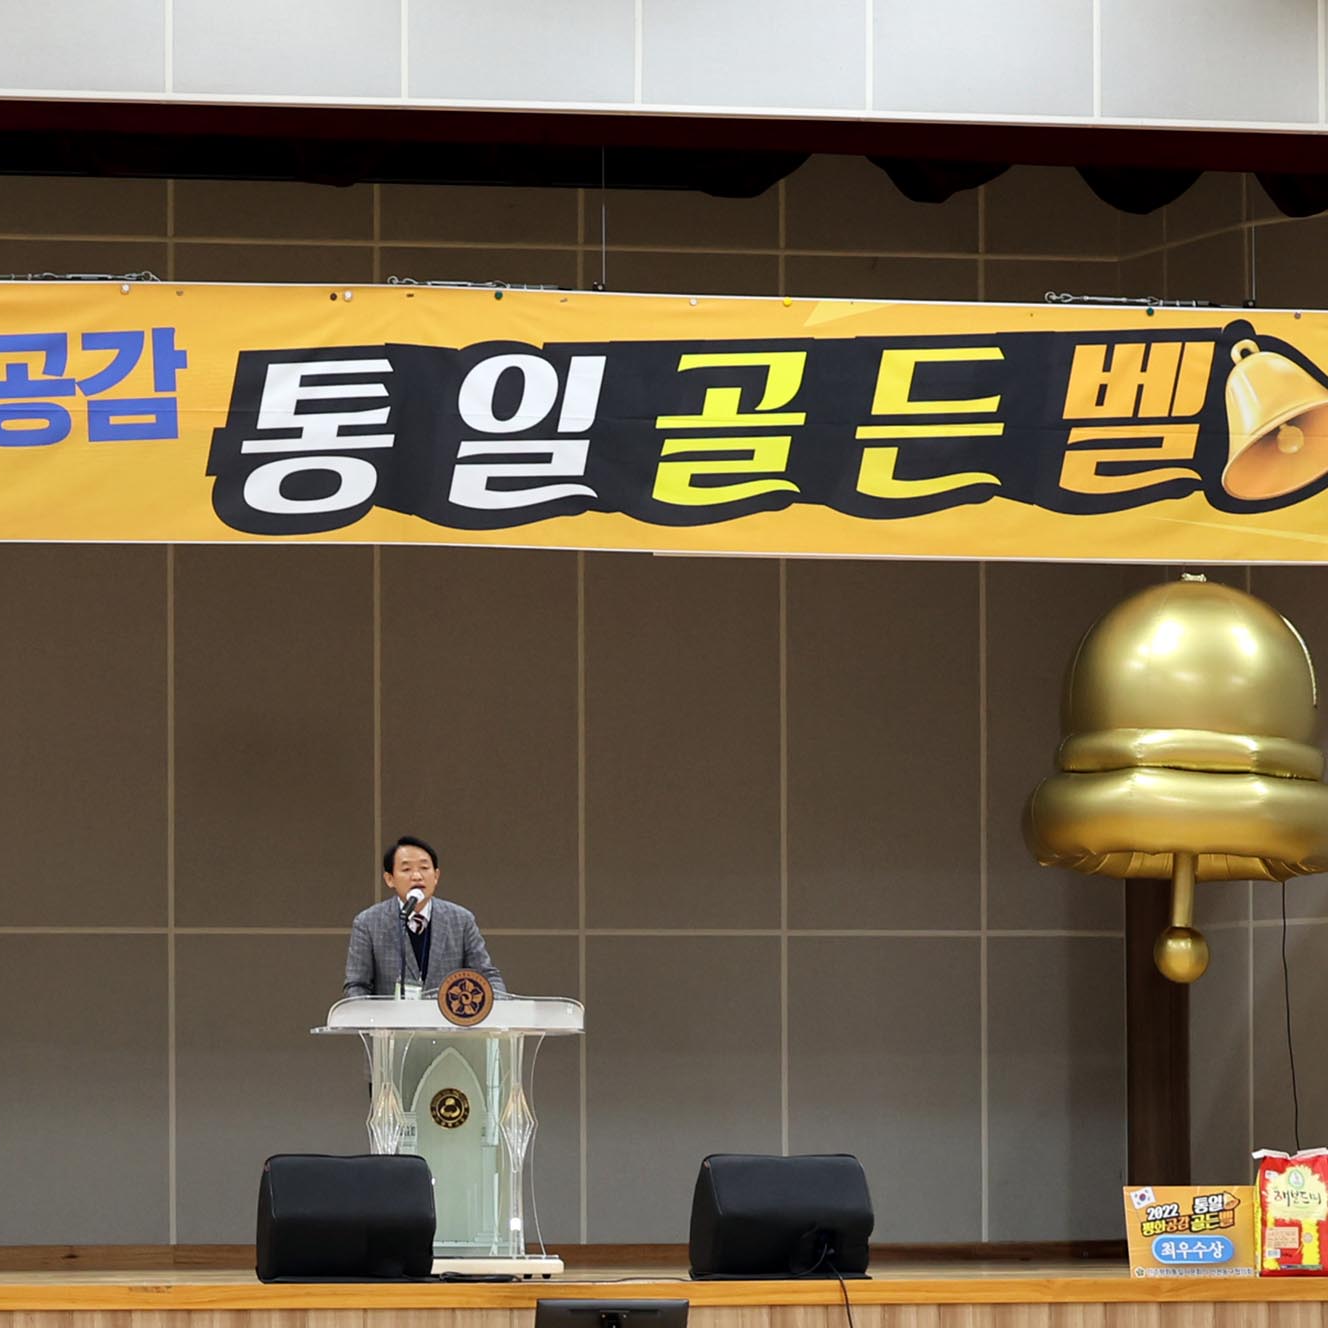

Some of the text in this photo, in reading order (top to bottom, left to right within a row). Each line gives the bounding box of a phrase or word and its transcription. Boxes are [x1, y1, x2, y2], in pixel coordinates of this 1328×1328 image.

[1147, 1195, 1223, 1220] 2022 통일
[1142, 1216, 1189, 1236] 평화공감
[1161, 1241, 1224, 1259] 최우수상
